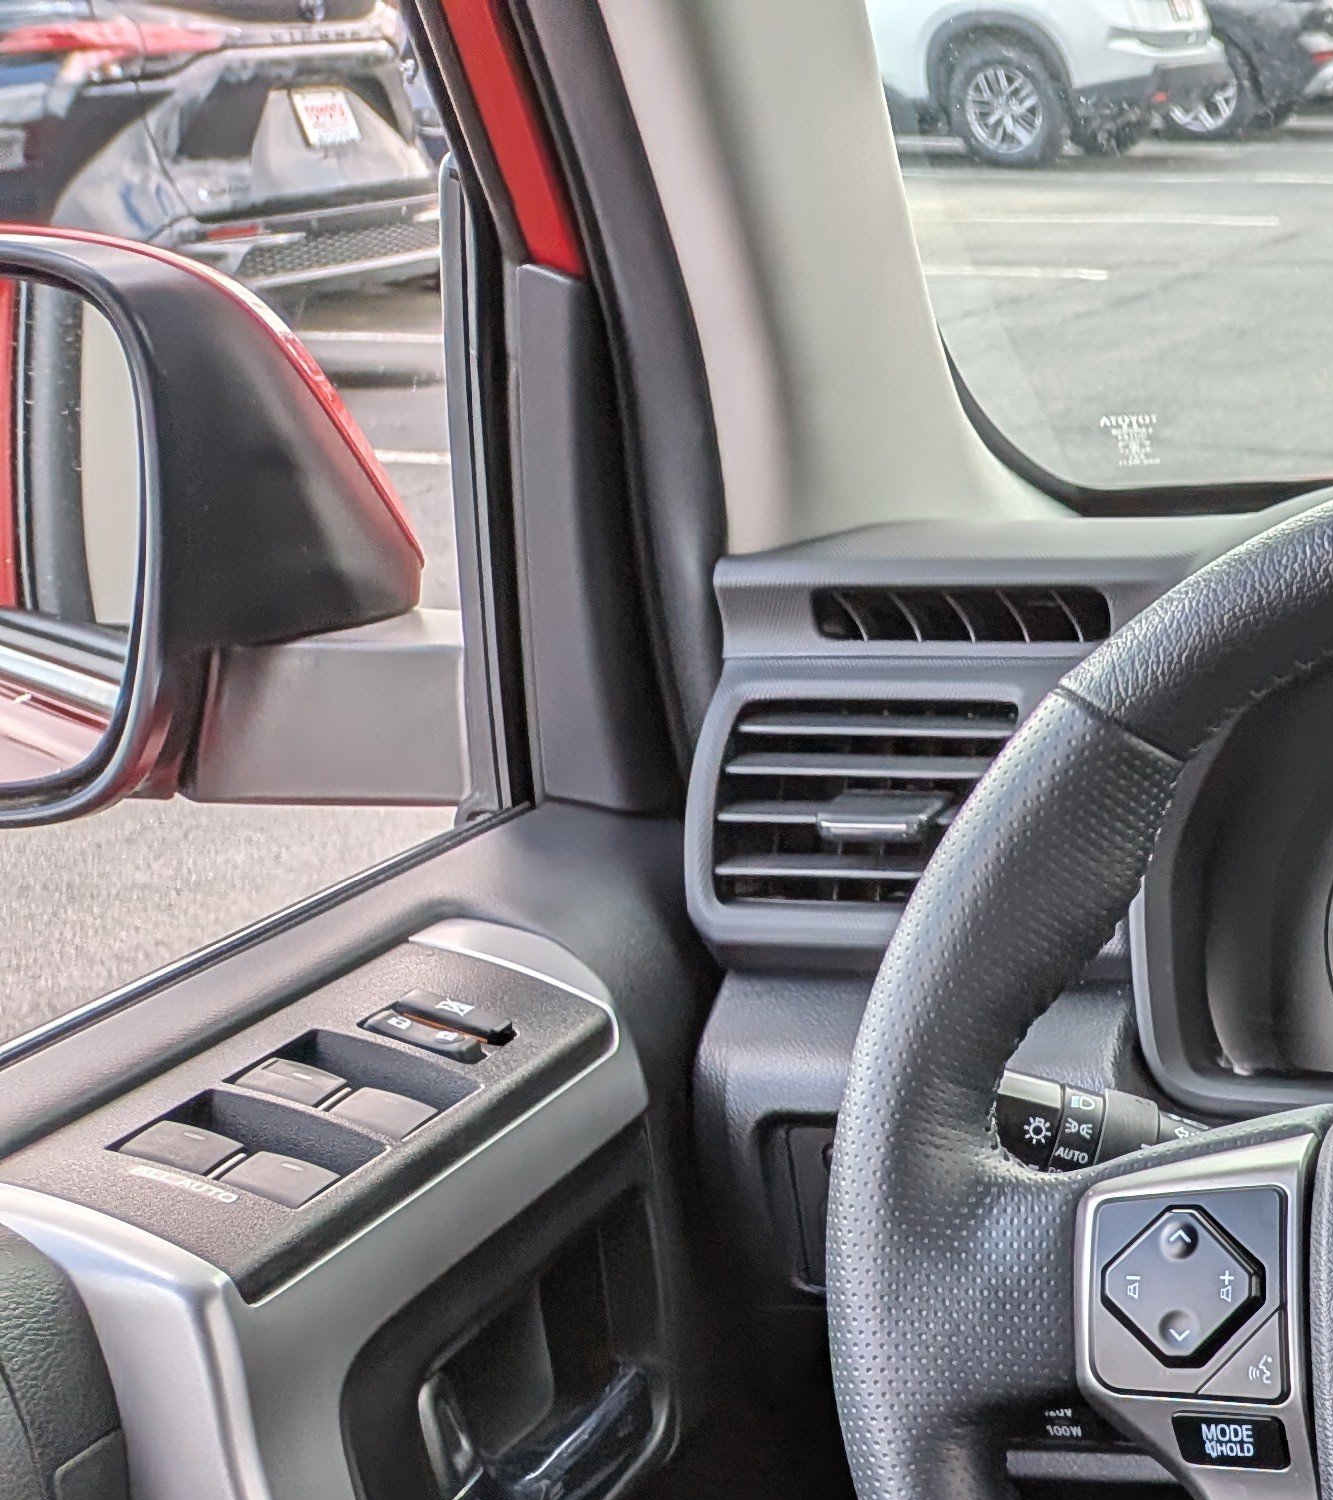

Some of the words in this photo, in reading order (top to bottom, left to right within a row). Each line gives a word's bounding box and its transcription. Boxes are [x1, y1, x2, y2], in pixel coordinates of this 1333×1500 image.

[1054, 1146, 1089, 1164] AUTO
[1046, 1424, 1082, 1437] 100W
[1201, 1423, 1254, 1442] MODE
[1216, 1442, 1254, 1457] HOLD
